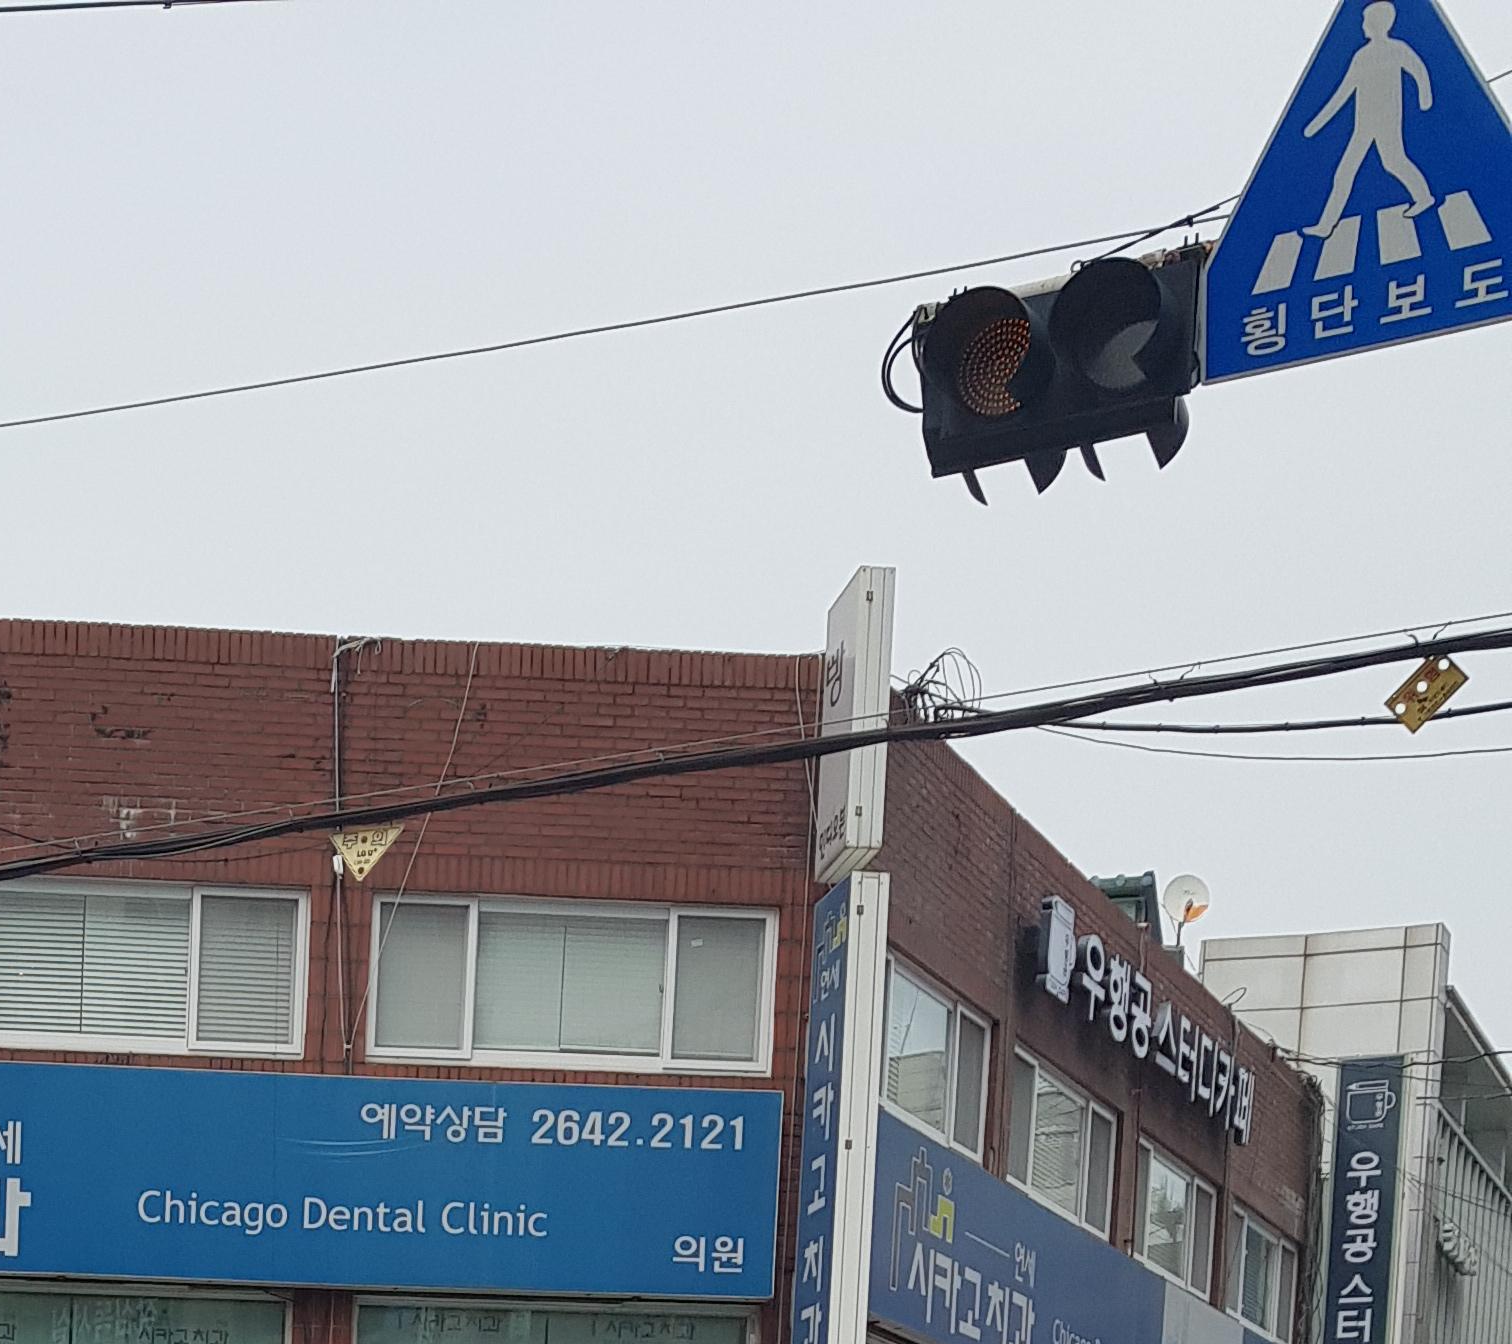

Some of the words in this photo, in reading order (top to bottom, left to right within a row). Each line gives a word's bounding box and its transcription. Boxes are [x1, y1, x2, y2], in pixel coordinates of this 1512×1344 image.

[1241, 258, 1509, 356] 횡단보도
[821, 960, 839, 1000] 연세
[1078, 934, 1152, 1058] 우행공
[1152, 1000, 1255, 1146] 스터디카페
[361, 1103, 507, 1144] 예약상담
[531, 1109, 744, 1150] 2642.2121
[137, 1191, 288, 1235] Chicago
[303, 1197, 425, 1234] Dental
[441, 1202, 548, 1237] Clinic
[1342, 1150, 1381, 1265] 우행공
[673, 1236, 745, 1274] 의원
[1014, 1241, 1036, 1287] 연세
